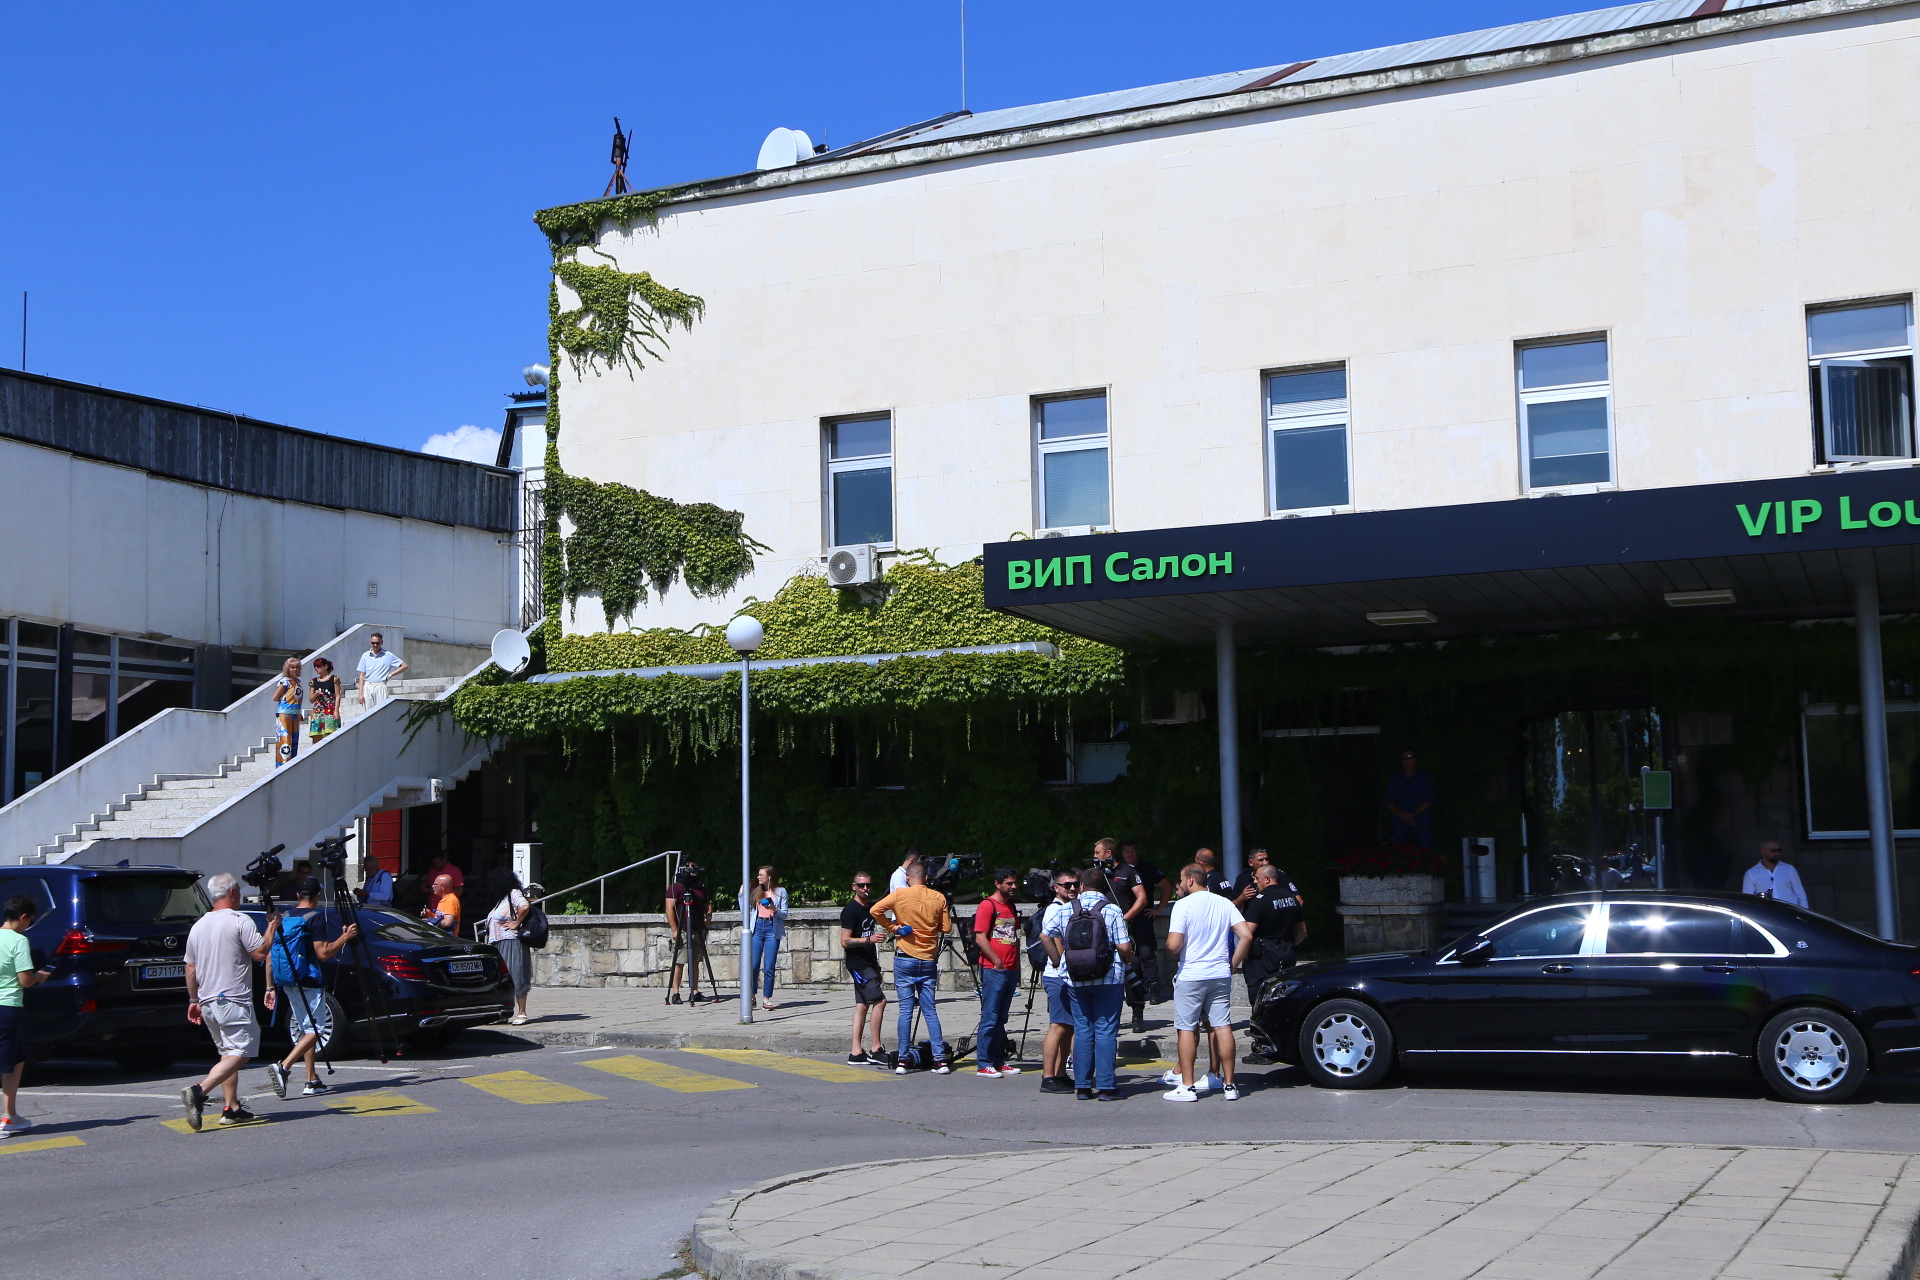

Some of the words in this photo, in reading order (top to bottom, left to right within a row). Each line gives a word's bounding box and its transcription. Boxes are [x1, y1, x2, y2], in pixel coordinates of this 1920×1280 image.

[1736, 498, 1823, 537] VIP
[1007, 554, 1092, 590] ВИП
[1104, 551, 1233, 583] Салон
